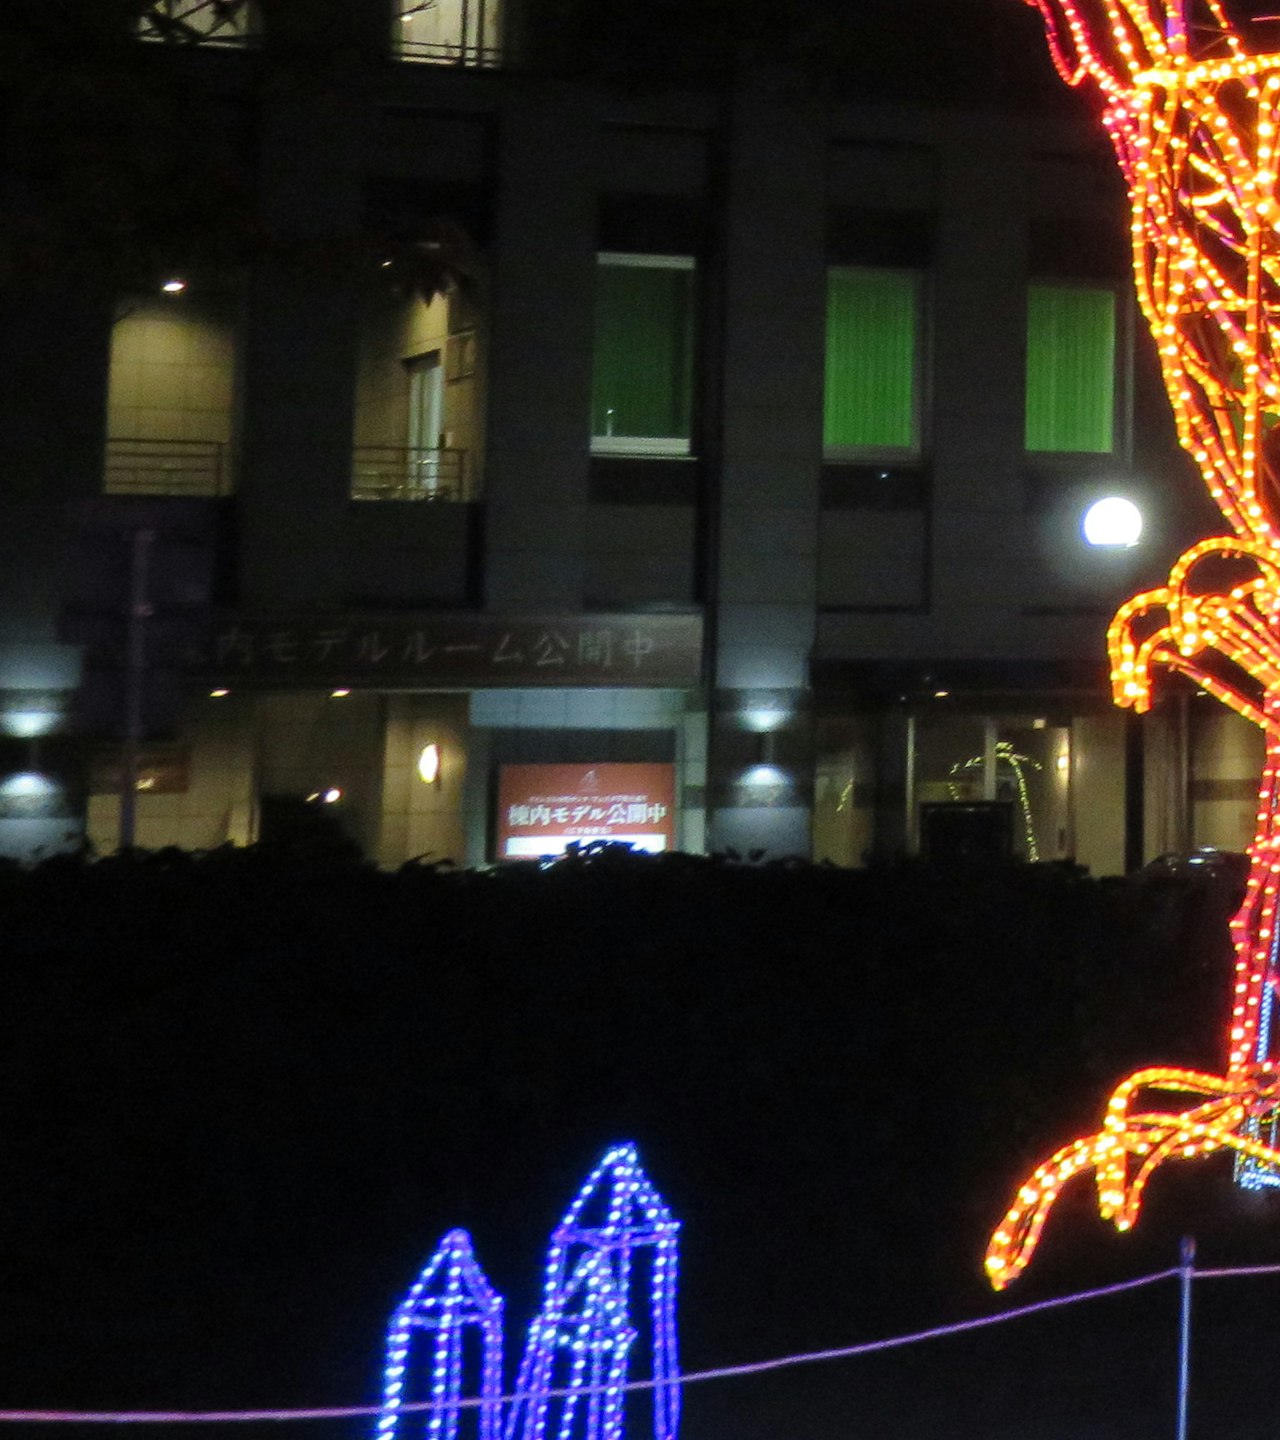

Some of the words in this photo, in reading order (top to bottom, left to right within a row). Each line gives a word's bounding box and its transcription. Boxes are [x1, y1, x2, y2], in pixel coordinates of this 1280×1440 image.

[183, 626, 656, 669] 内モデルルーム公開中
